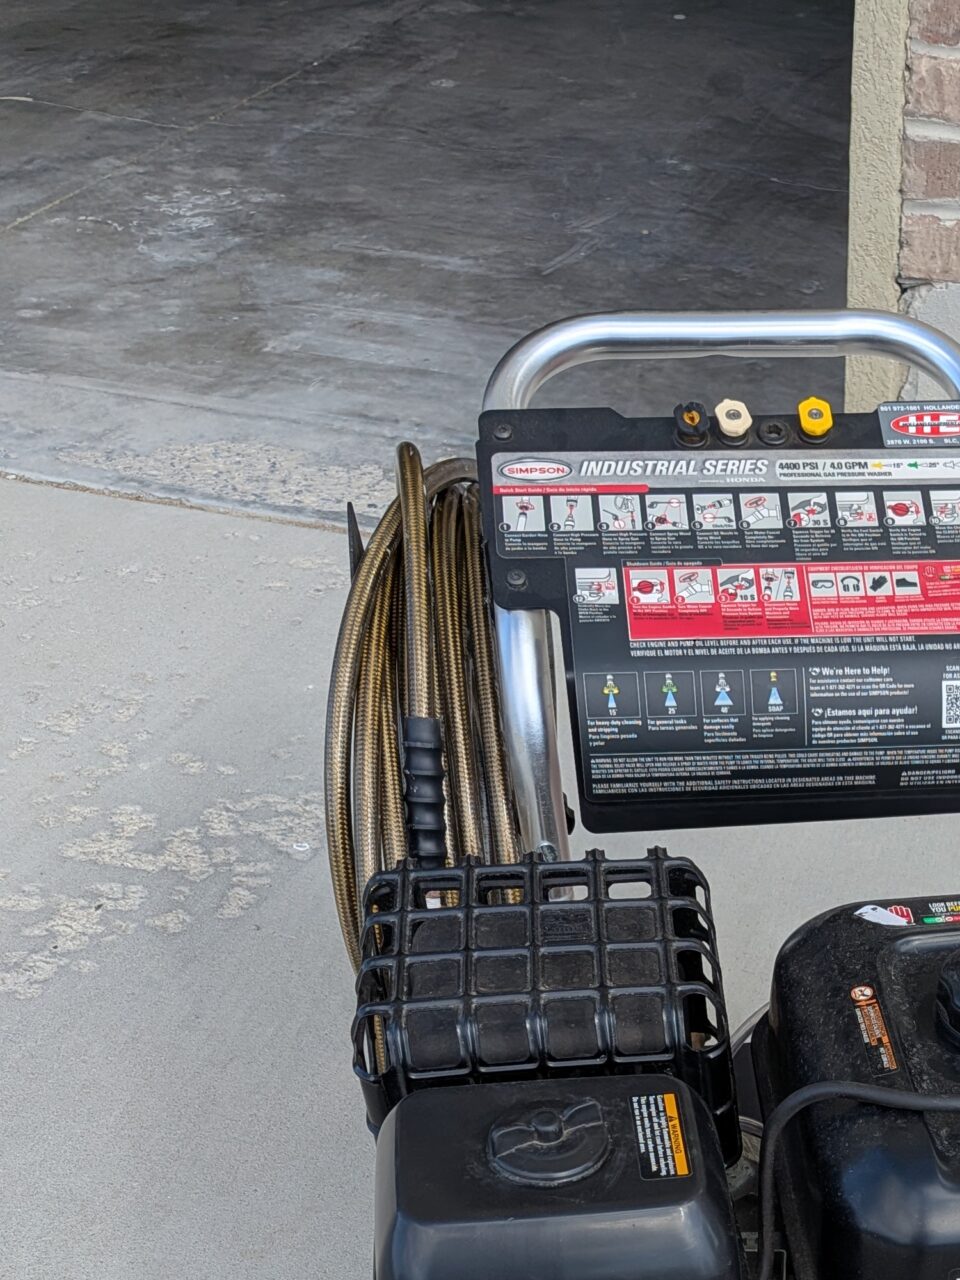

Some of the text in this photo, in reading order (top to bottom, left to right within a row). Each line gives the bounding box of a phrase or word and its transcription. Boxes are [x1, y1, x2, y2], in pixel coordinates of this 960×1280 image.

[580, 460, 769, 476] INDUSTRIAL SERIES
[778, 462, 800, 470] 4400
[822, 667, 843, 676] We're
[844, 666, 861, 675] Here
[871, 666, 890, 676] Help!
[824, 708, 856, 718] ¡Estamos
[874, 708, 890, 717] para
[892, 705, 918, 716] ayudar!
[671, 1124, 682, 1154] WARNING
